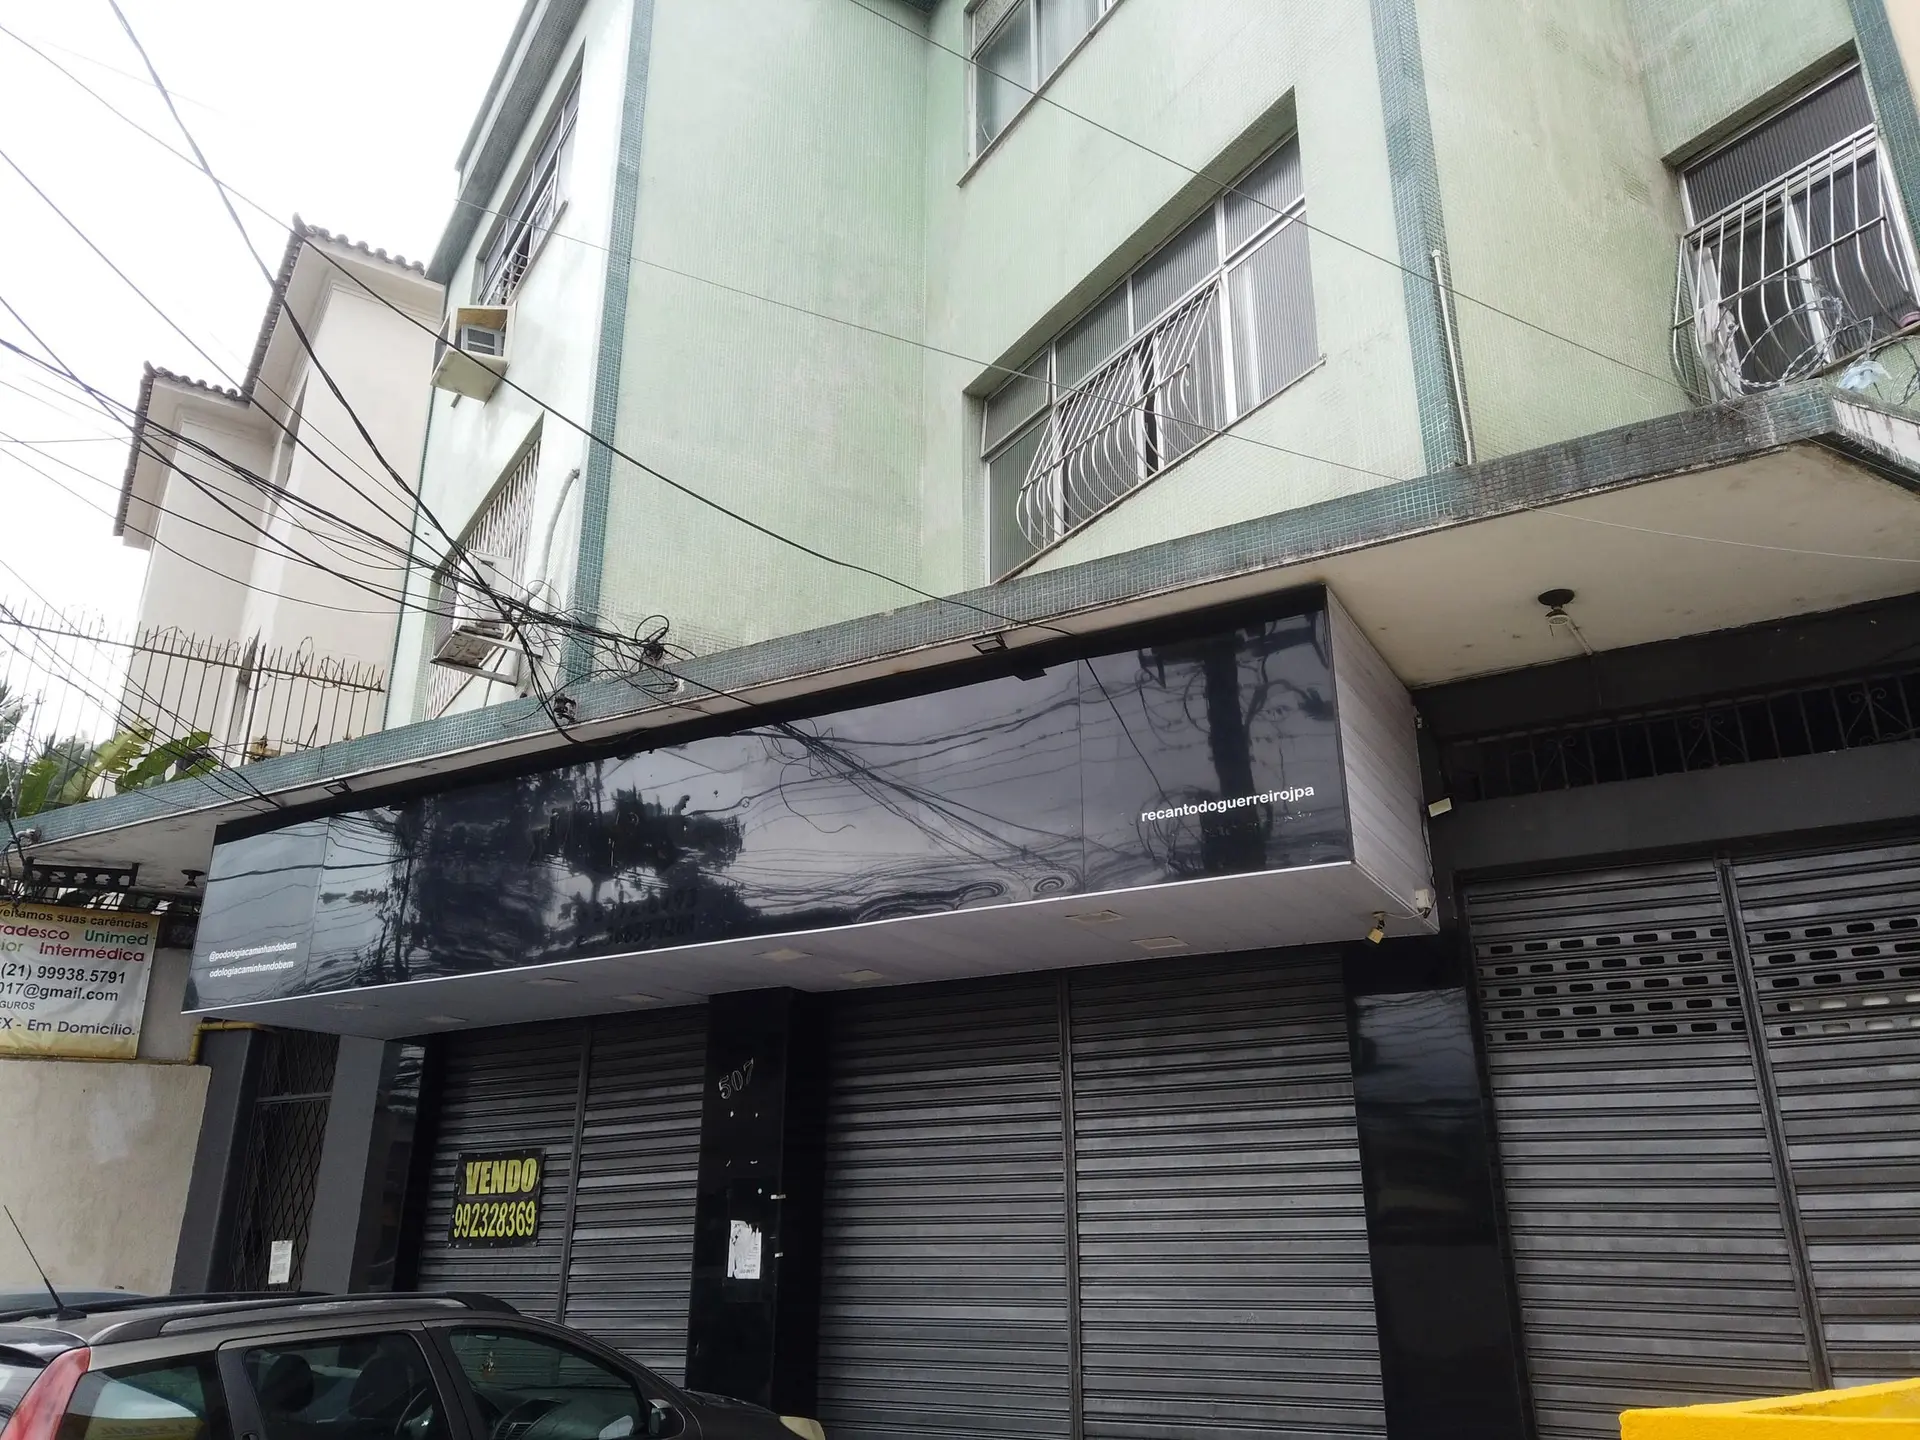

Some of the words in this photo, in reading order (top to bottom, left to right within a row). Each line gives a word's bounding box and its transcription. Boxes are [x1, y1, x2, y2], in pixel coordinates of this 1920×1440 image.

[1141, 786, 1315, 822] recantodoguerreirojpa
[57, 913, 87, 925] suas
[90, 917, 149, 929] carências
[84, 929, 149, 946] Unimed
[39, 941, 145, 962] Intermédica
[209, 942, 297, 962] @podologiacaminhandobem
[1, 963, 32, 981] (21)
[37, 965, 126, 984] 99938.5791
[27, 1019, 52, 1032] Em
[57, 1021, 136, 1036] Domicílio.
[718, 1057, 754, 1100] 507
[465, 1158, 538, 1195] VENDO
[453, 1200, 537, 1238] 992328369
